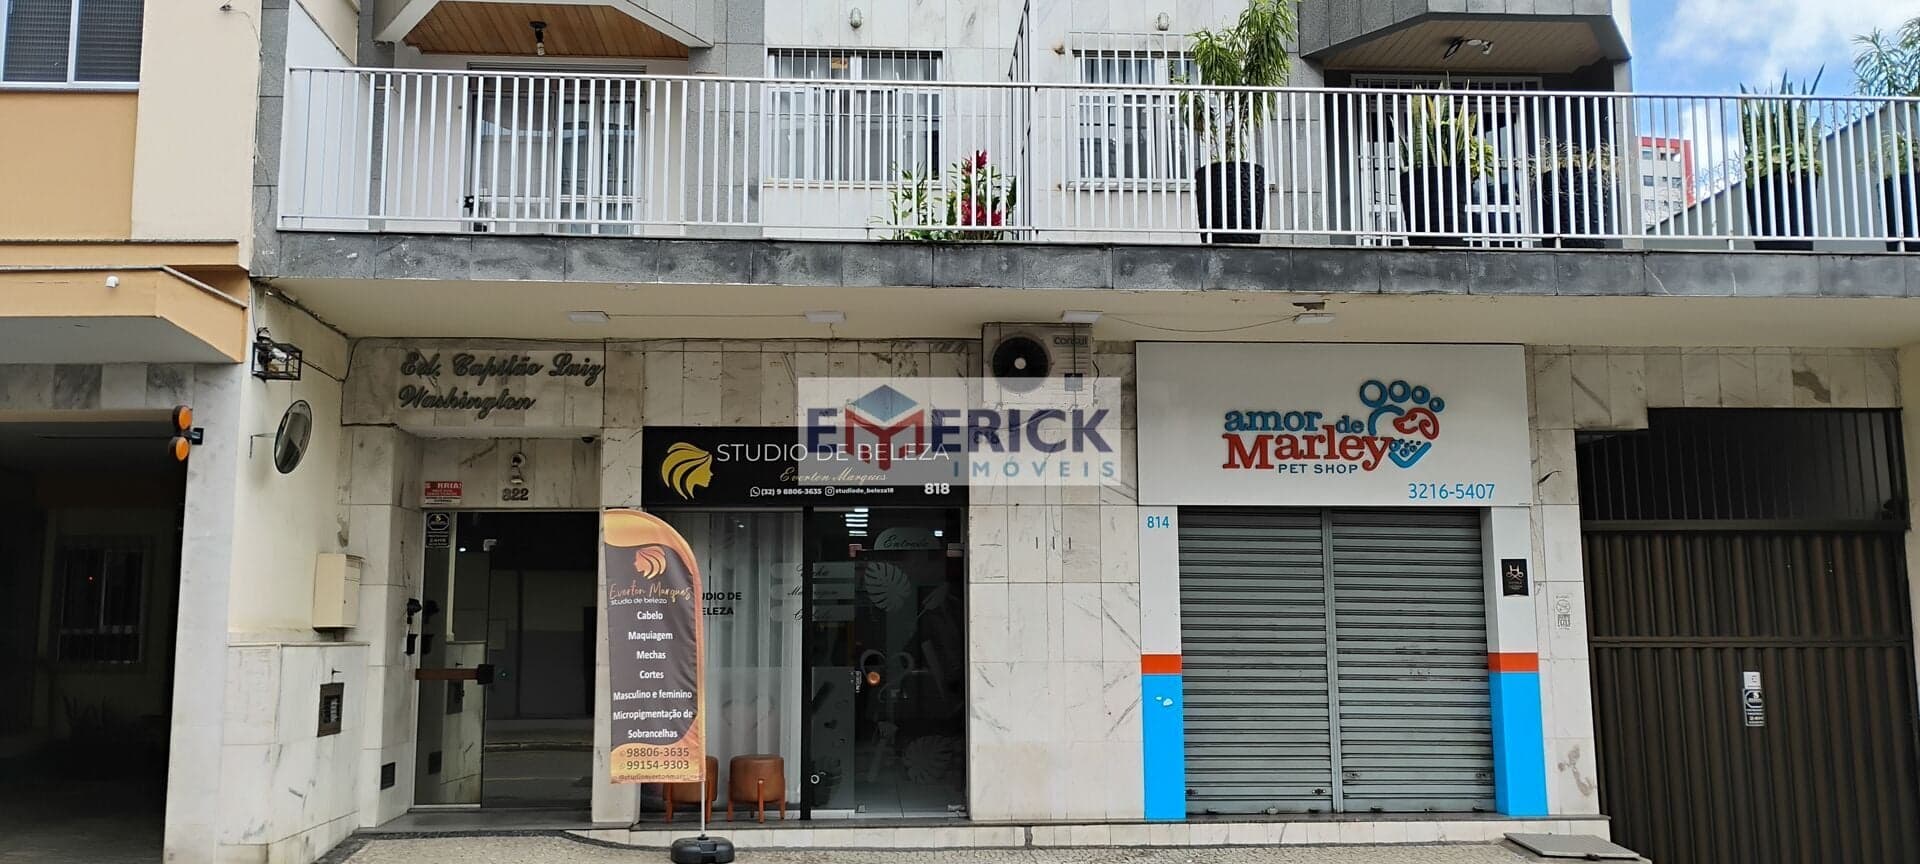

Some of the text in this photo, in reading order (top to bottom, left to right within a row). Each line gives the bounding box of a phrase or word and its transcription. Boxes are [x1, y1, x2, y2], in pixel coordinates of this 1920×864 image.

[400, 351, 605, 387] Ed. Capitão Luiz
[398, 384, 537, 420] Washington
[1223, 409, 1365, 435] amor de
[716, 443, 951, 462] STUDIO DE BELEZA
[1221, 424, 1395, 472] Marley
[1278, 463, 1359, 475] PET SHOP
[779, 466, 887, 485] Everton Marques
[761, 488, 775, 496] (32)
[776, 488, 782, 496] 9
[924, 483, 950, 495] 818
[1407, 482, 1496, 500] 3216-5407
[1146, 515, 1170, 529] 814
[609, 580, 693, 603] Everton Marques
[727, 592, 742, 601] DE
[643, 596, 668, 604] beleza
[636, 611, 664, 620] Cabelo
[702, 606, 734, 616] ELEZA
[628, 631, 674, 642] Maquiagem
[636, 650, 667, 660] Mechas
[639, 670, 665, 679] Cortes
[613, 689, 693, 701] Masculino e feminino
[612, 709, 694, 721] Micropigmentação de
[627, 729, 678, 739] Sobrancelhas
[626, 747, 690, 757] 98806-3635
[626, 760, 690, 770] 99154-9303
